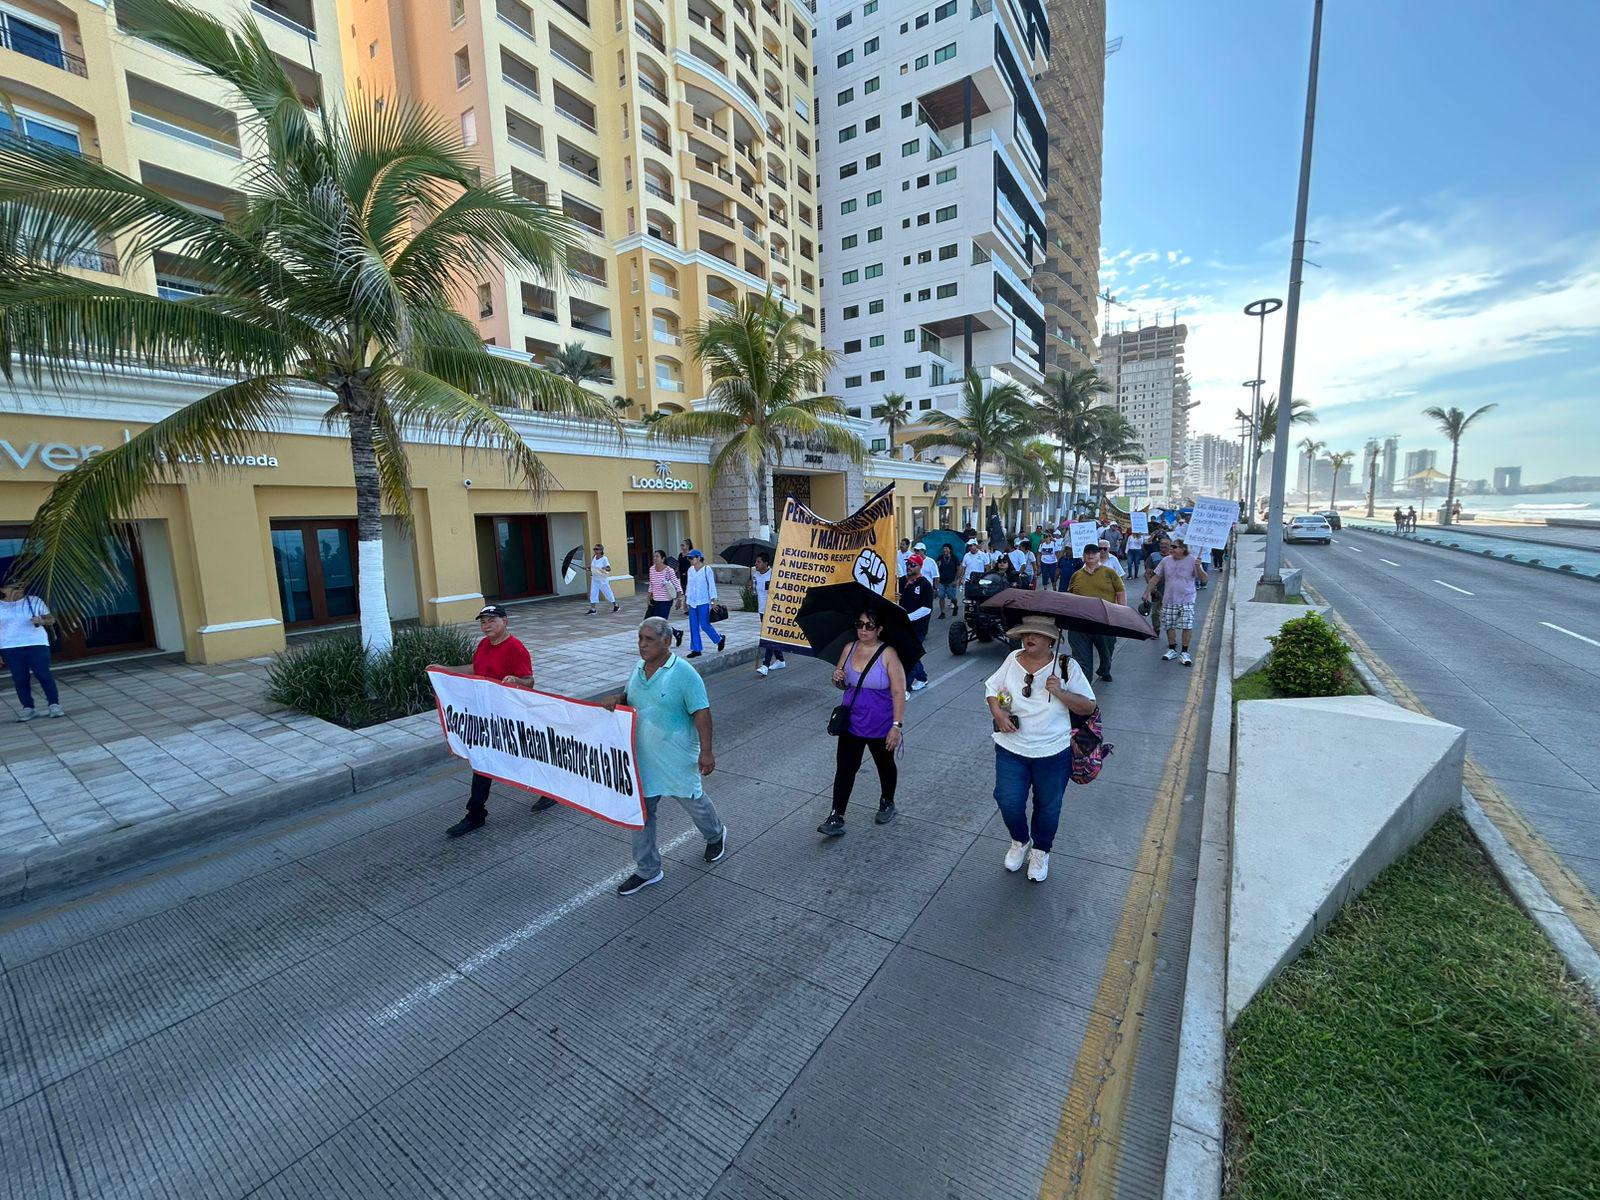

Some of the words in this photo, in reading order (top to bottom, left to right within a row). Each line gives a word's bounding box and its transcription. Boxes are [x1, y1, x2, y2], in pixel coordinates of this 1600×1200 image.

[0, 440, 103, 471] ver
[810, 528, 818, 547] Y
[830, 553, 856, 562] RESPET
[789, 560, 836, 573] NUESTROS
[778, 570, 827, 584] DERECHOS
[776, 581, 807, 593] LABOR
[773, 593, 802, 604] ADQUI
[771, 604, 782, 612] EL
[785, 607, 799, 615] CO
[769, 615, 798, 627] COLEC
[767, 626, 807, 641] TRABAJO
[516, 720, 549, 763] Matan
[547, 726, 588, 780] Maestros
[589, 745, 600, 783] en
[600, 743, 612, 788] la
[610, 747, 634, 797] UAS
